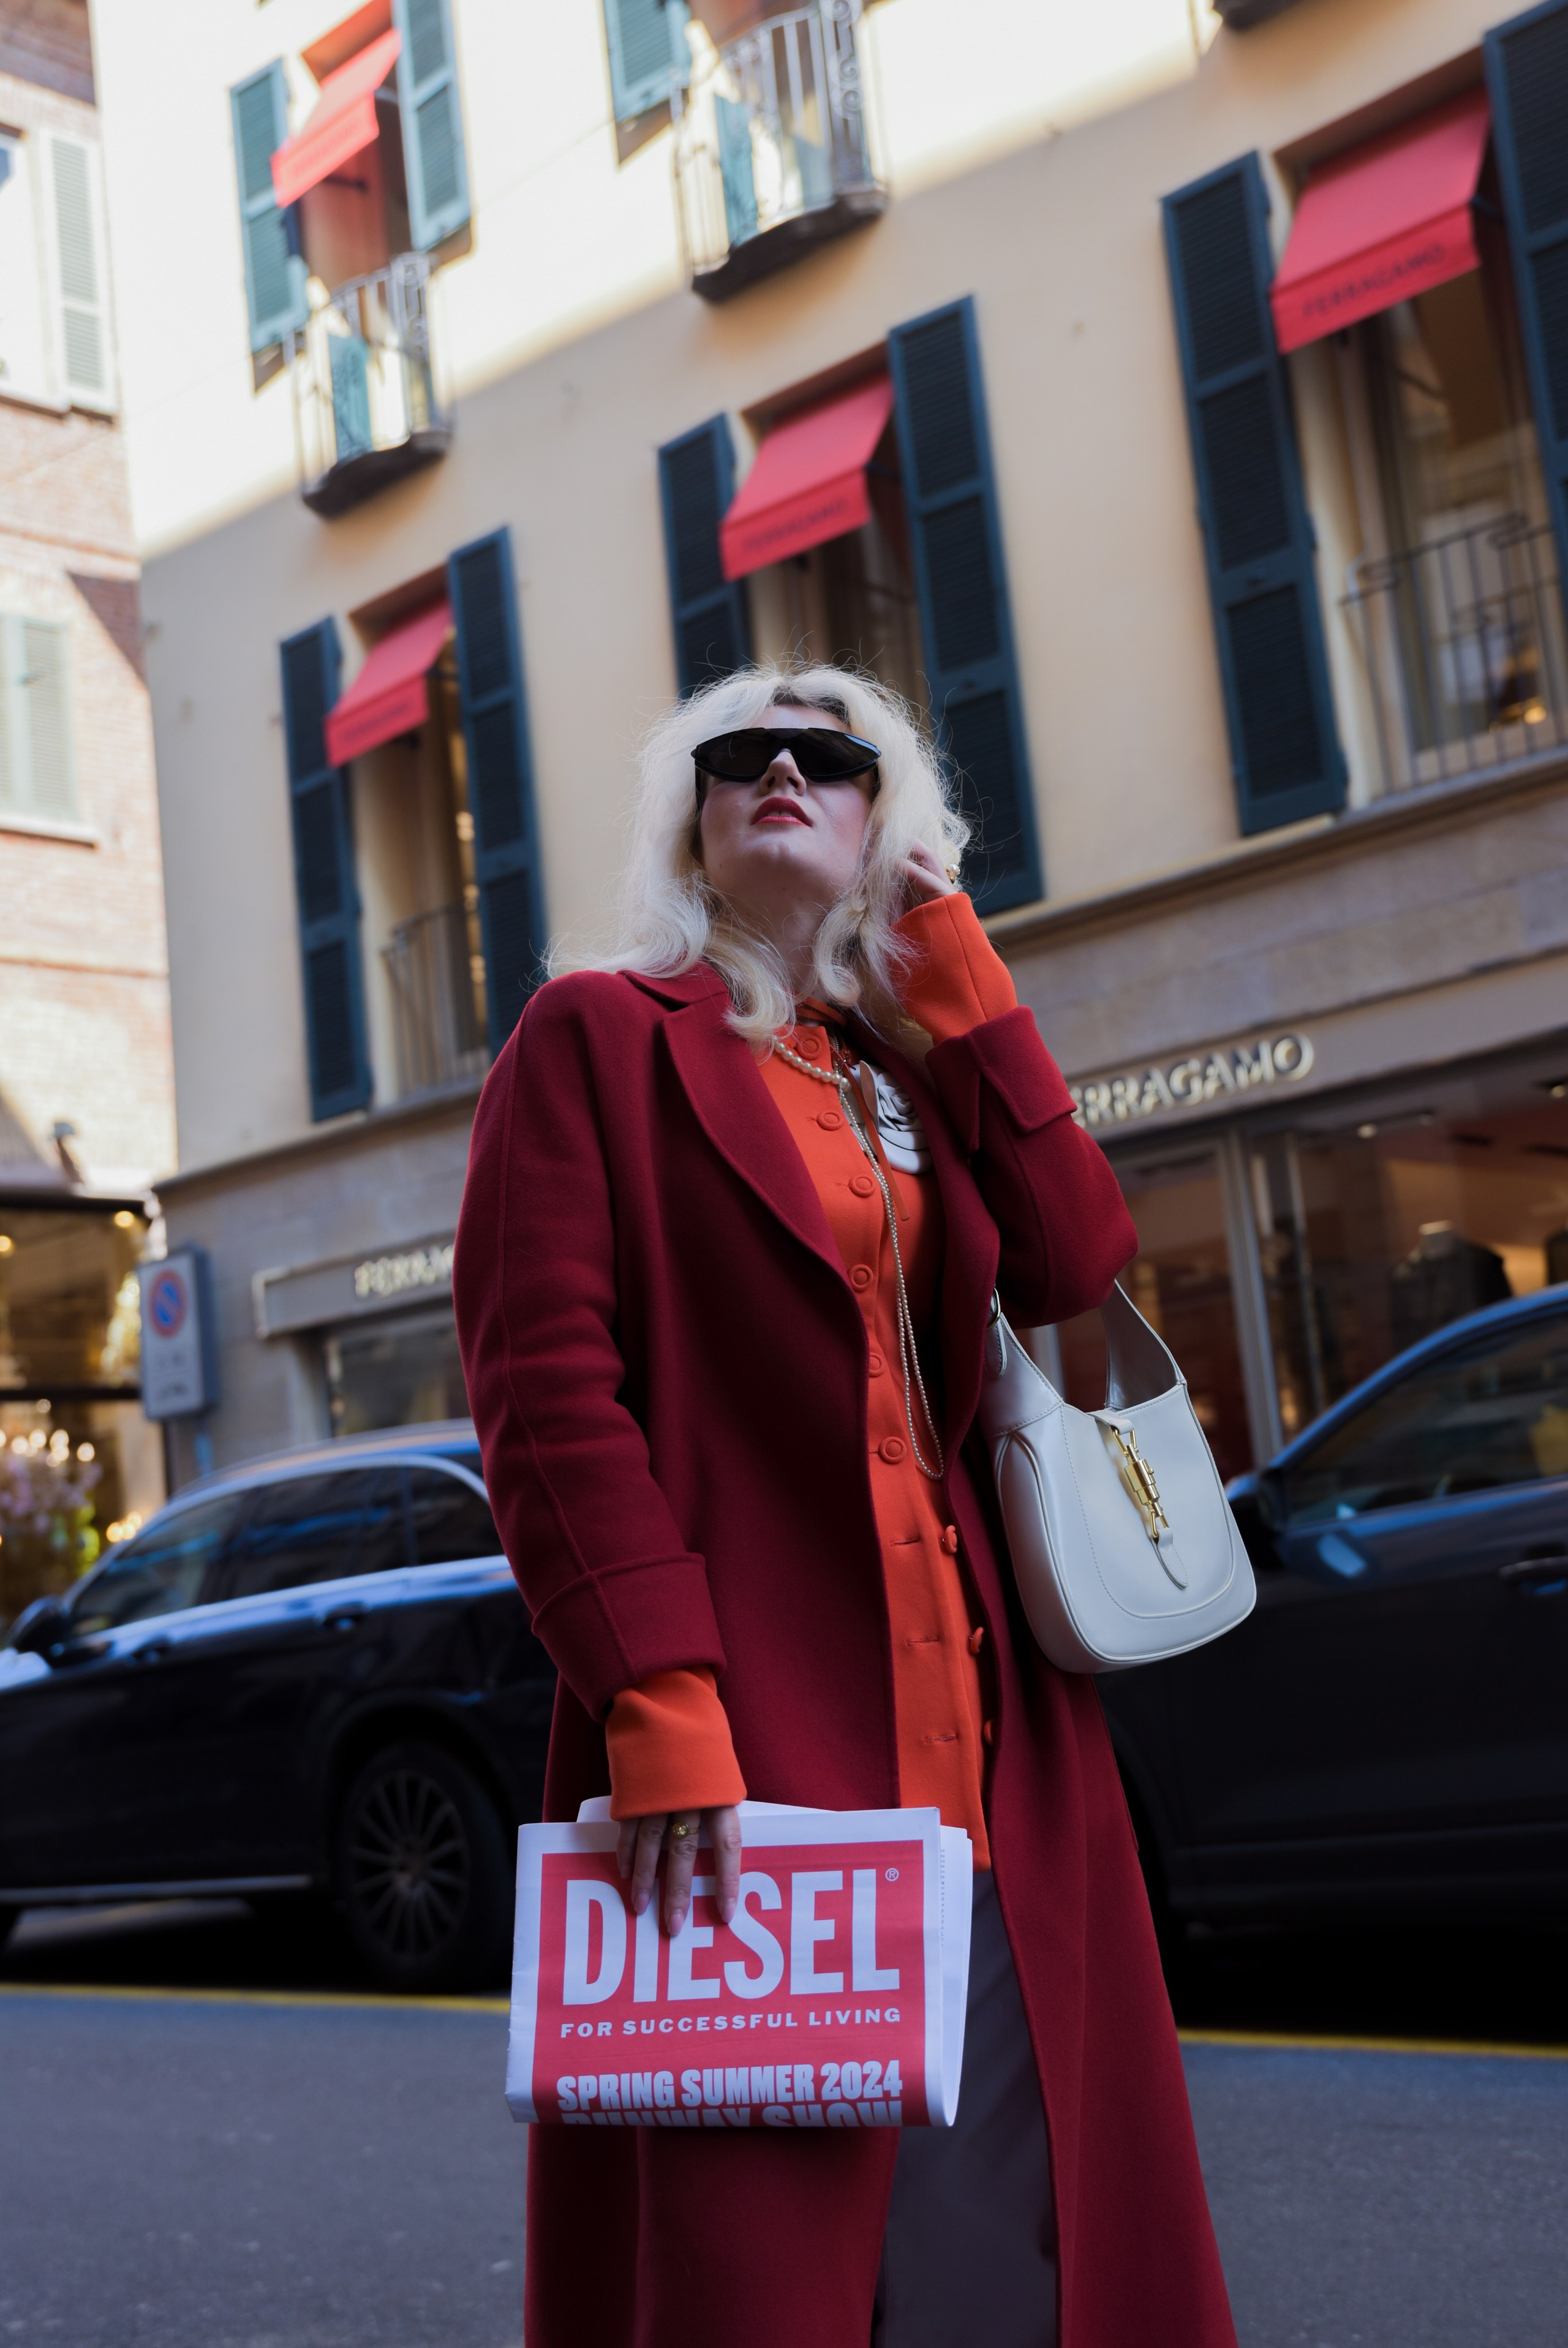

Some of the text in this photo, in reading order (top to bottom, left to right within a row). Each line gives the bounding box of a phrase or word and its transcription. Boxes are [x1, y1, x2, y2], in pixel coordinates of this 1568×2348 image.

[562, 1868, 900, 2006] DIESEL
[560, 2007, 900, 2038] FOR SUCCESSFUL LIVING
[557, 2059, 903, 2111] SPRING SUMMER 2024
